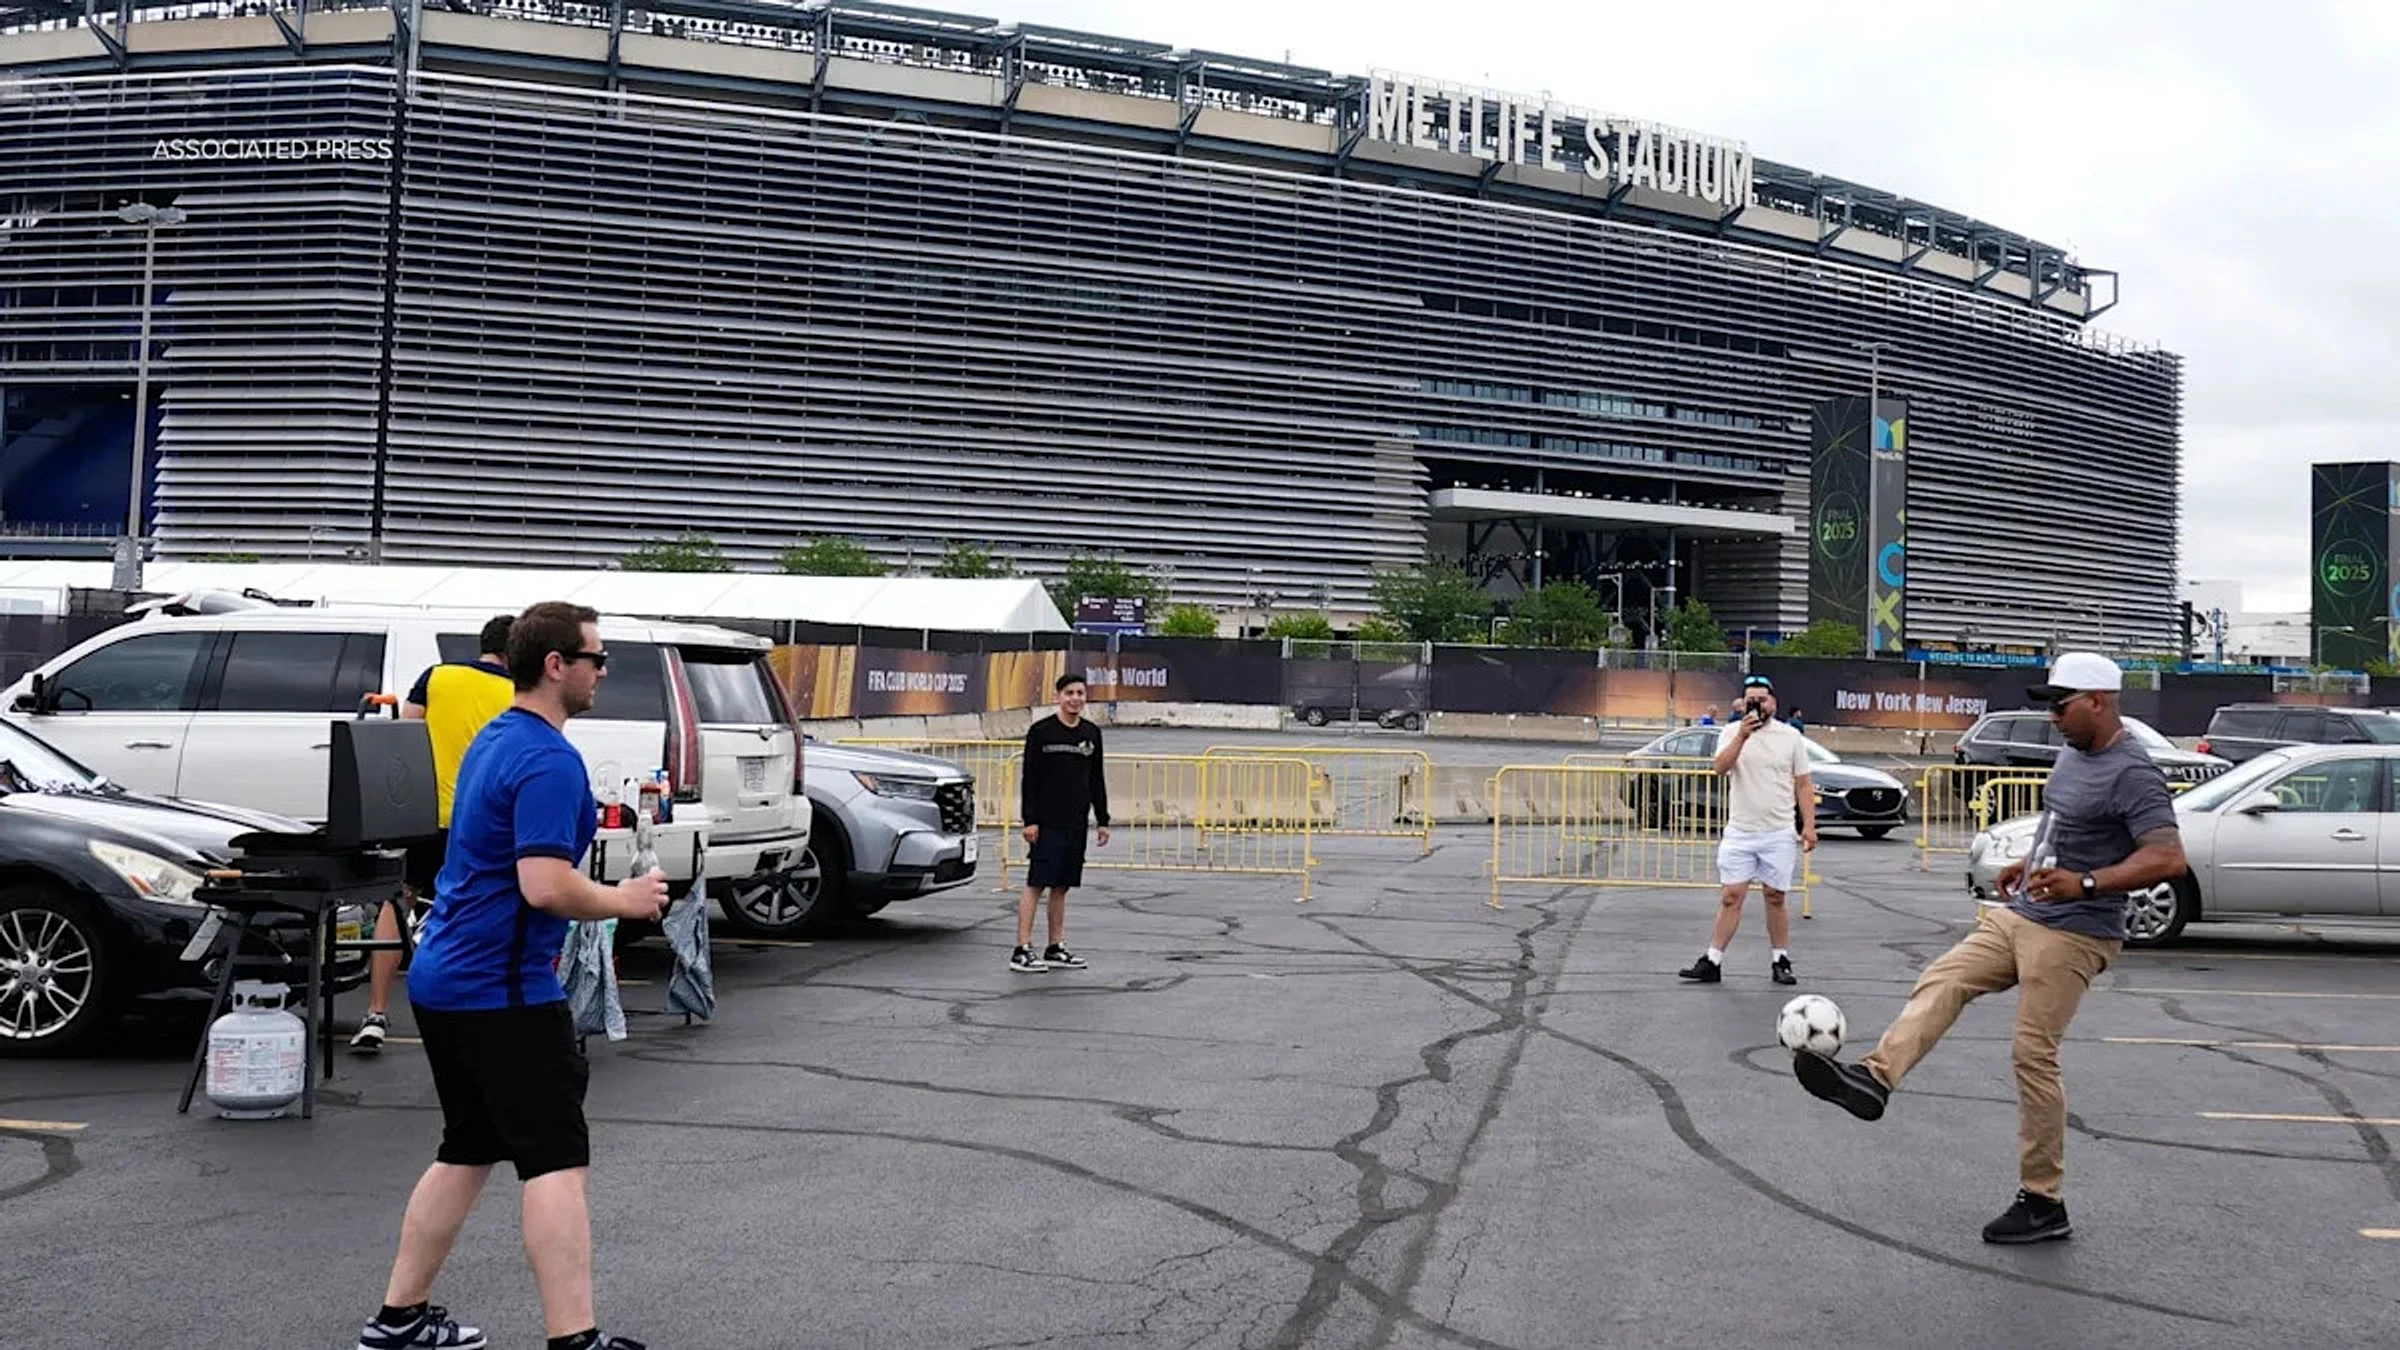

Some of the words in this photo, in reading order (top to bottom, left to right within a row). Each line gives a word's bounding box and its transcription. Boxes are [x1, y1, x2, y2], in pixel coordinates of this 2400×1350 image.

[152, 138, 308, 160] ASSOCIATED
[316, 138, 394, 160] PRESS
[1367, 77, 1567, 172] METLIFE
[1583, 115, 1755, 208] STADIUM
[1822, 520, 1856, 541] 2025
[2328, 564, 2370, 581] 2025
[868, 670, 886, 691] FIFA
[1122, 668, 1168, 687] World
[1836, 690, 1872, 710] New
[1875, 692, 1911, 712] York
[1915, 694, 1943, 713] New
[1945, 695, 1988, 716] Jersey
